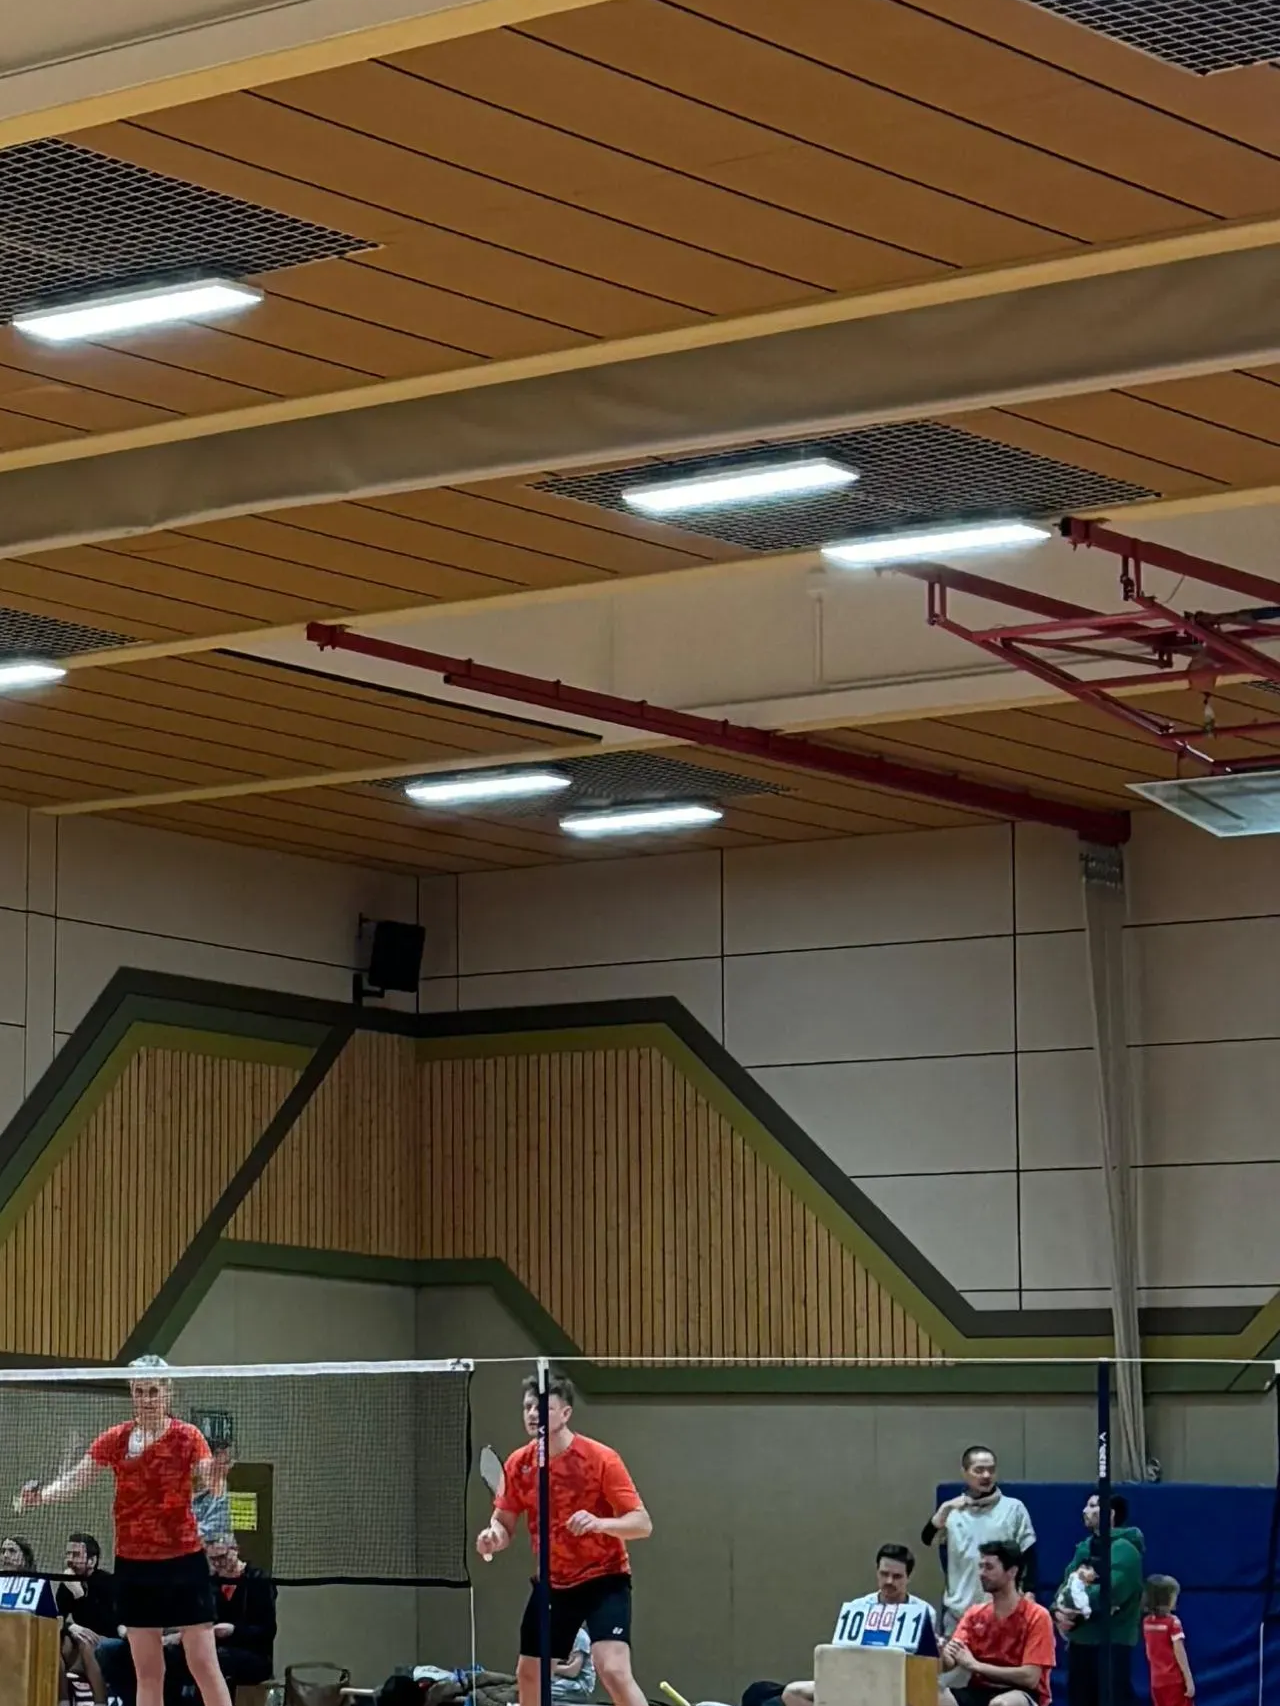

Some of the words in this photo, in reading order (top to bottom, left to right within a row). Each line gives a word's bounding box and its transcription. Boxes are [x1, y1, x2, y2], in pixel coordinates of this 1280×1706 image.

[22, 1577, 39, 1605] 5
[838, 1609, 865, 1641] 10
[895, 1611, 923, 1644] 11
